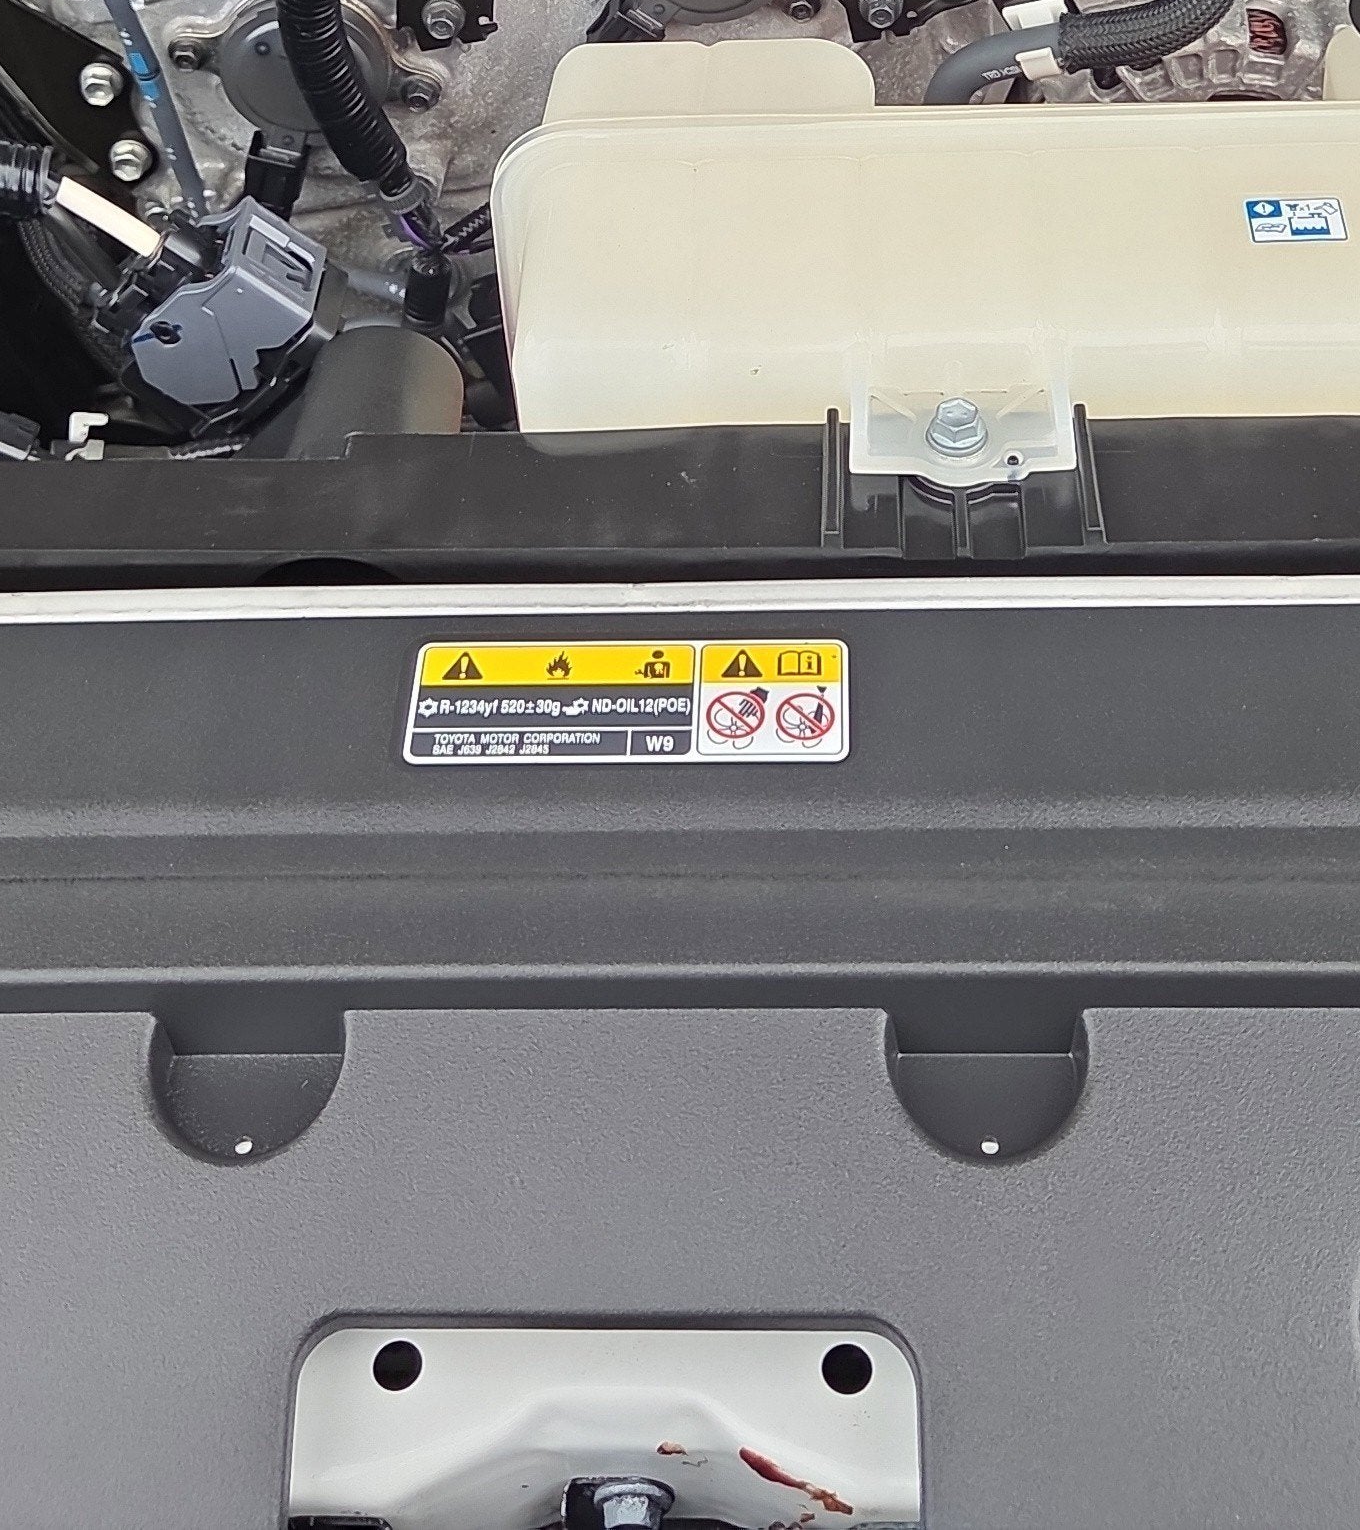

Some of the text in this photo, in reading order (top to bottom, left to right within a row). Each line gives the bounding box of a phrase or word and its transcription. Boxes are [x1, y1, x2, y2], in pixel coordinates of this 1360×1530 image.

[439, 698, 561, 718] R-1234yf 520±30g
[591, 698, 691, 717] ND-OIL12(POE)
[433, 732, 601, 745] TOYOTA MOTOR CORPORATION
[645, 736, 675, 753] W9
